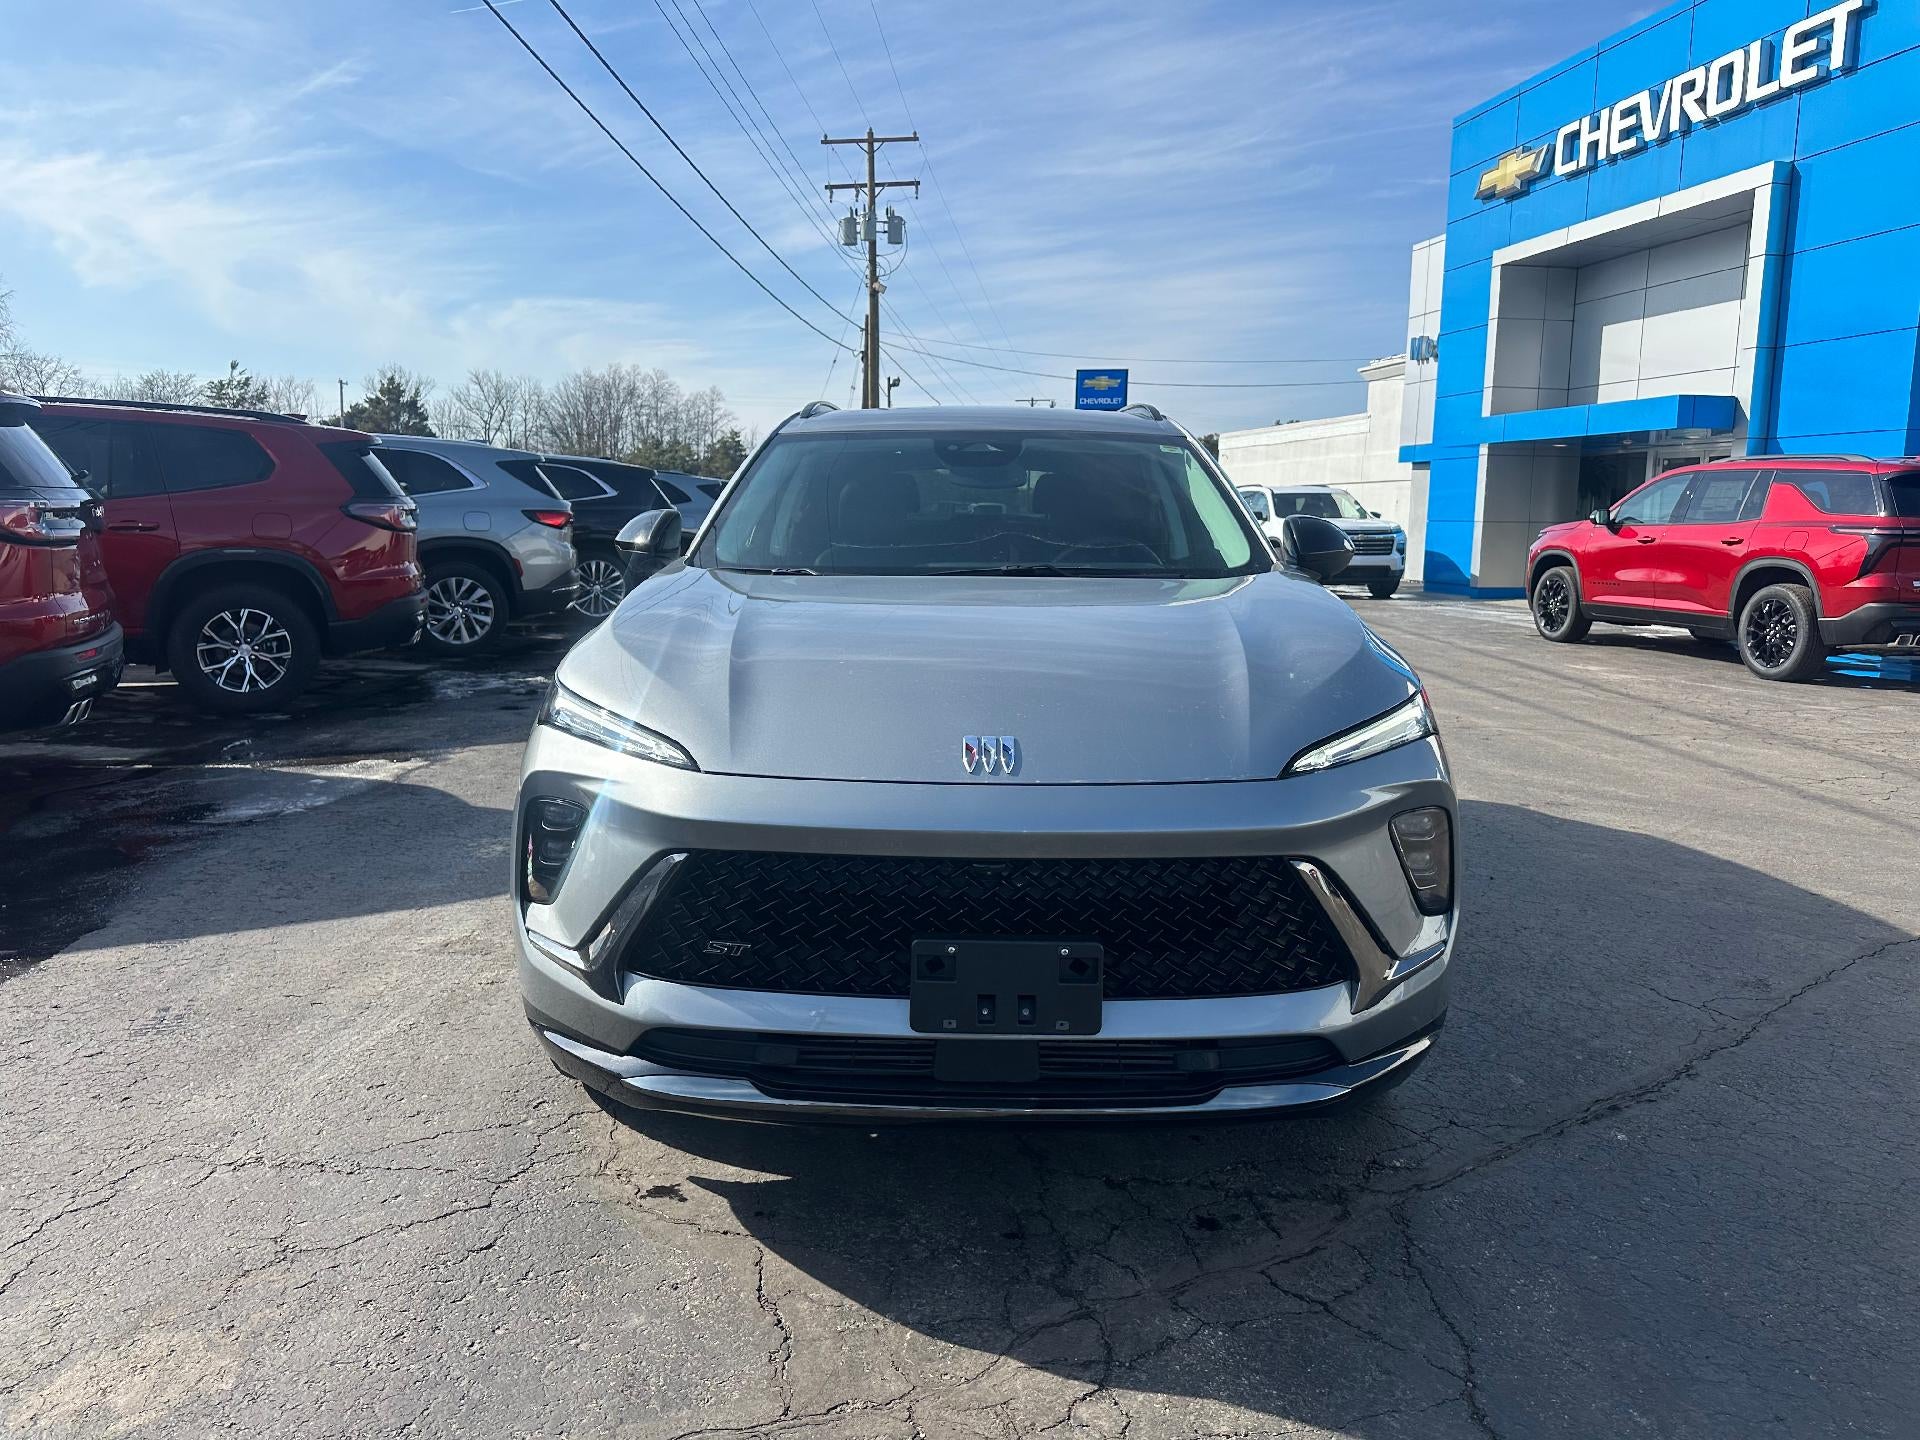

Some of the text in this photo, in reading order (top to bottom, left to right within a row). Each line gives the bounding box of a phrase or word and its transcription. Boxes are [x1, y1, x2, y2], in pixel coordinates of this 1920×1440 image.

[1554, 0, 1866, 177] CHEVROLET
[1080, 397, 1122, 405] CHEVROLET
[703, 941, 752, 957] ST
